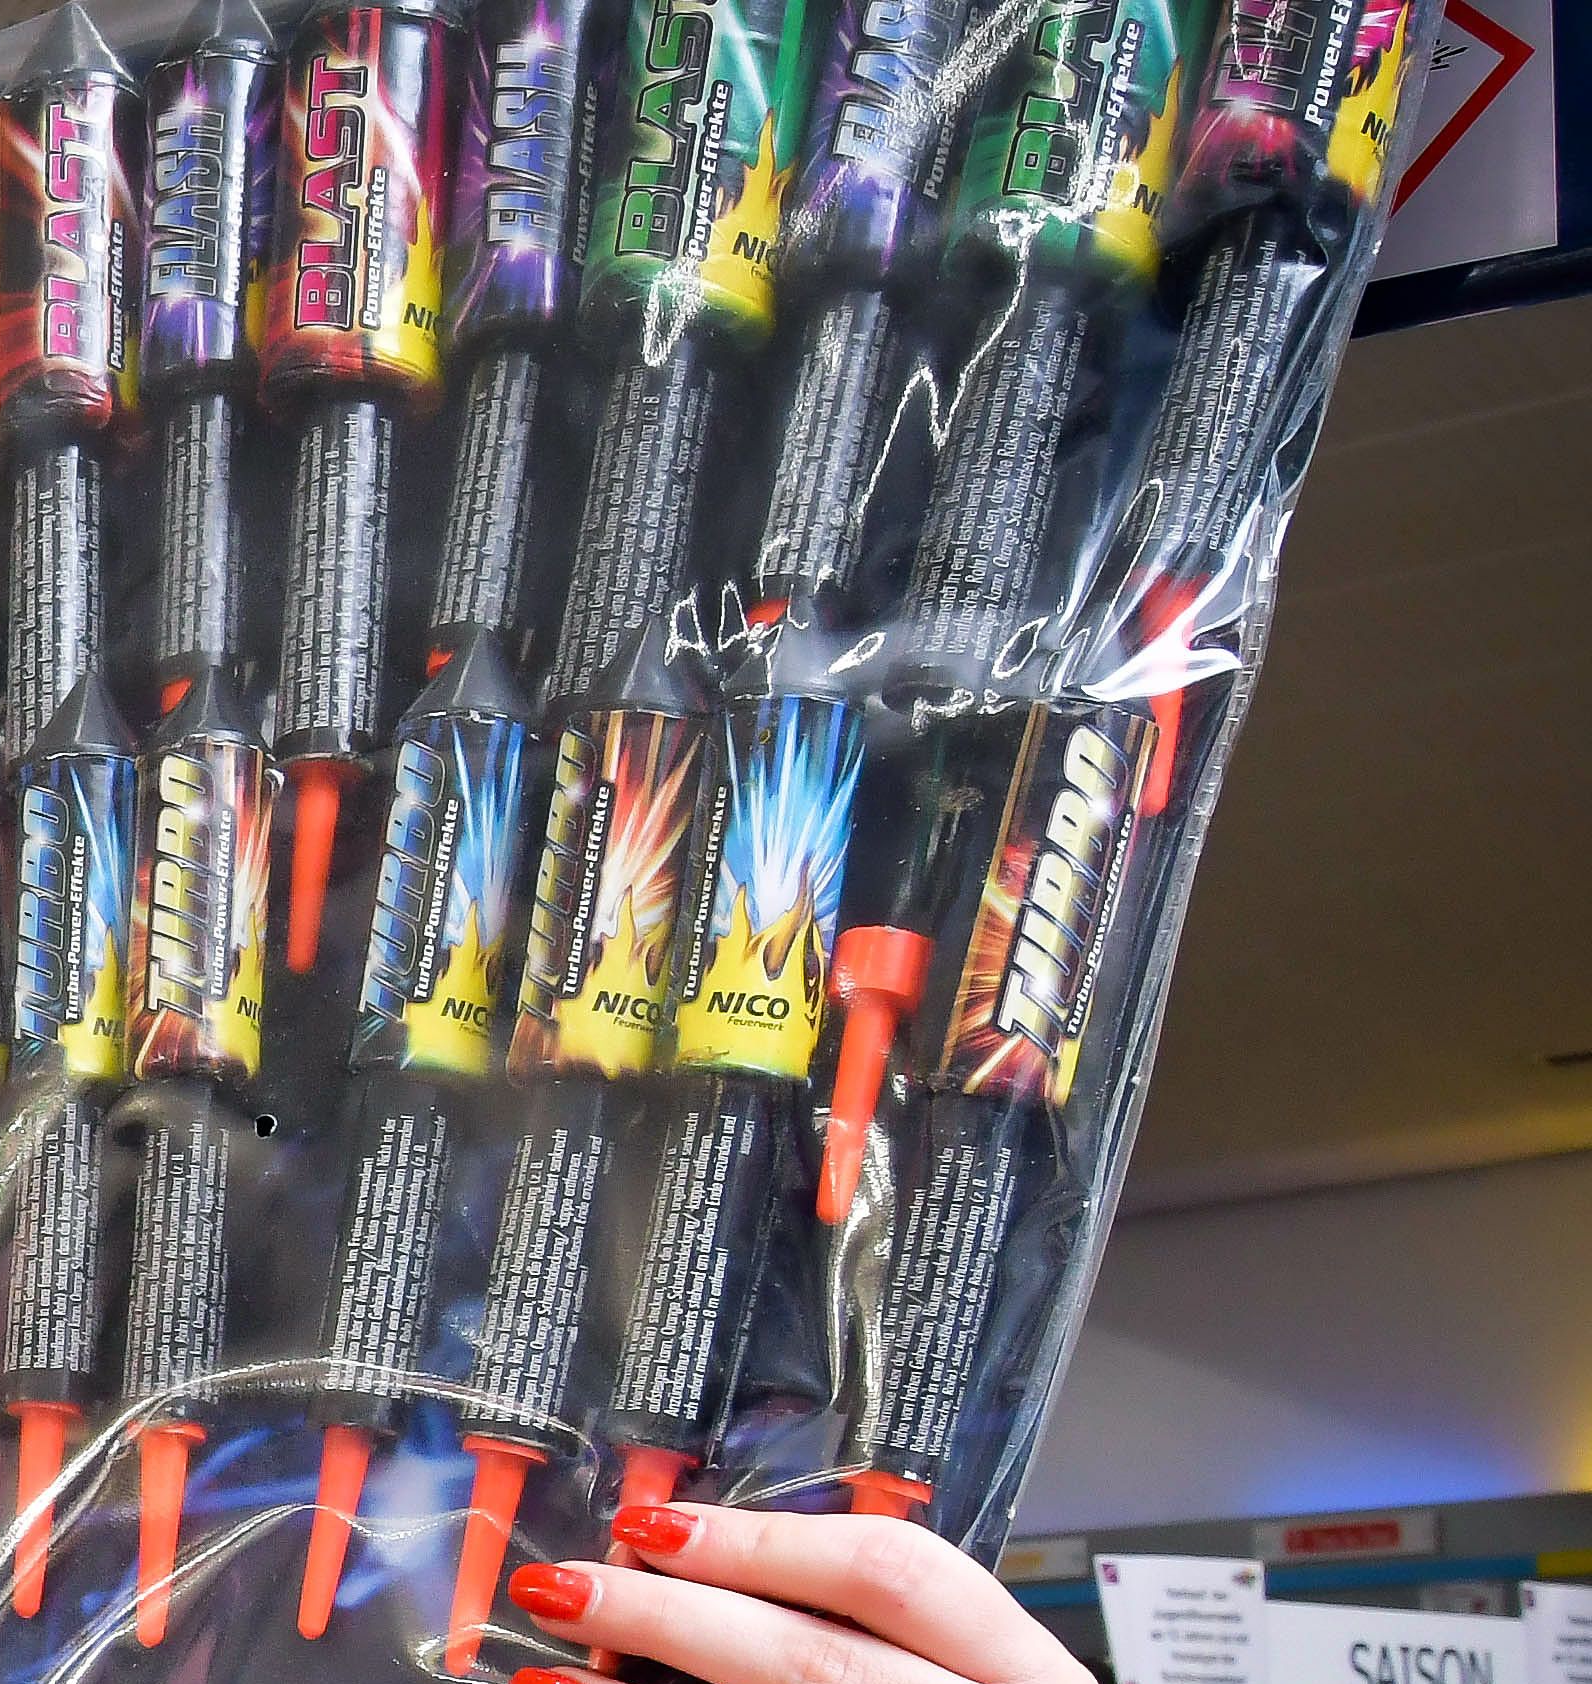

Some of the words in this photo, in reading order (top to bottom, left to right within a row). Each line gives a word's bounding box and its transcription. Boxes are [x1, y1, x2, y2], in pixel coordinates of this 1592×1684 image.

[45, 102, 111, 360] BLAST
[149, 107, 224, 298] FLASH
[297, 57, 368, 330] BLAST
[487, 39, 576, 255] FLASH
[686, 81, 731, 260] Power-Effekte
[108, 221, 125, 370] Power-Effekte
[363, 167, 387, 328] Power-Effekte
[16, 784, 70, 1042] TURBO
[65, 835, 86, 1021] Turbo-Power-Effekte
[149, 752, 216, 1018] TURBO
[211, 810, 234, 996] Turbo-Power-Effekte
[359, 739, 447, 1026] TURBO
[414, 799, 460, 998] Turbo-Power-Effekte
[518, 729, 598, 1021] TURBO
[562, 784, 610, 997] Turbo-Power-Effekte
[682, 785, 728, 999] Turbo-Power-Effekte
[993, 722, 1129, 1057] TURBO
[1066, 813, 1134, 1035] Turbo-Power-Effekte
[592, 991, 661, 1023] NICO
[706, 991, 790, 1020] NICO
[727, 1016, 785, 1032] Feuerwerk
[719, 1114, 737, 1134] und
[653, 1260, 670, 1284] dass
